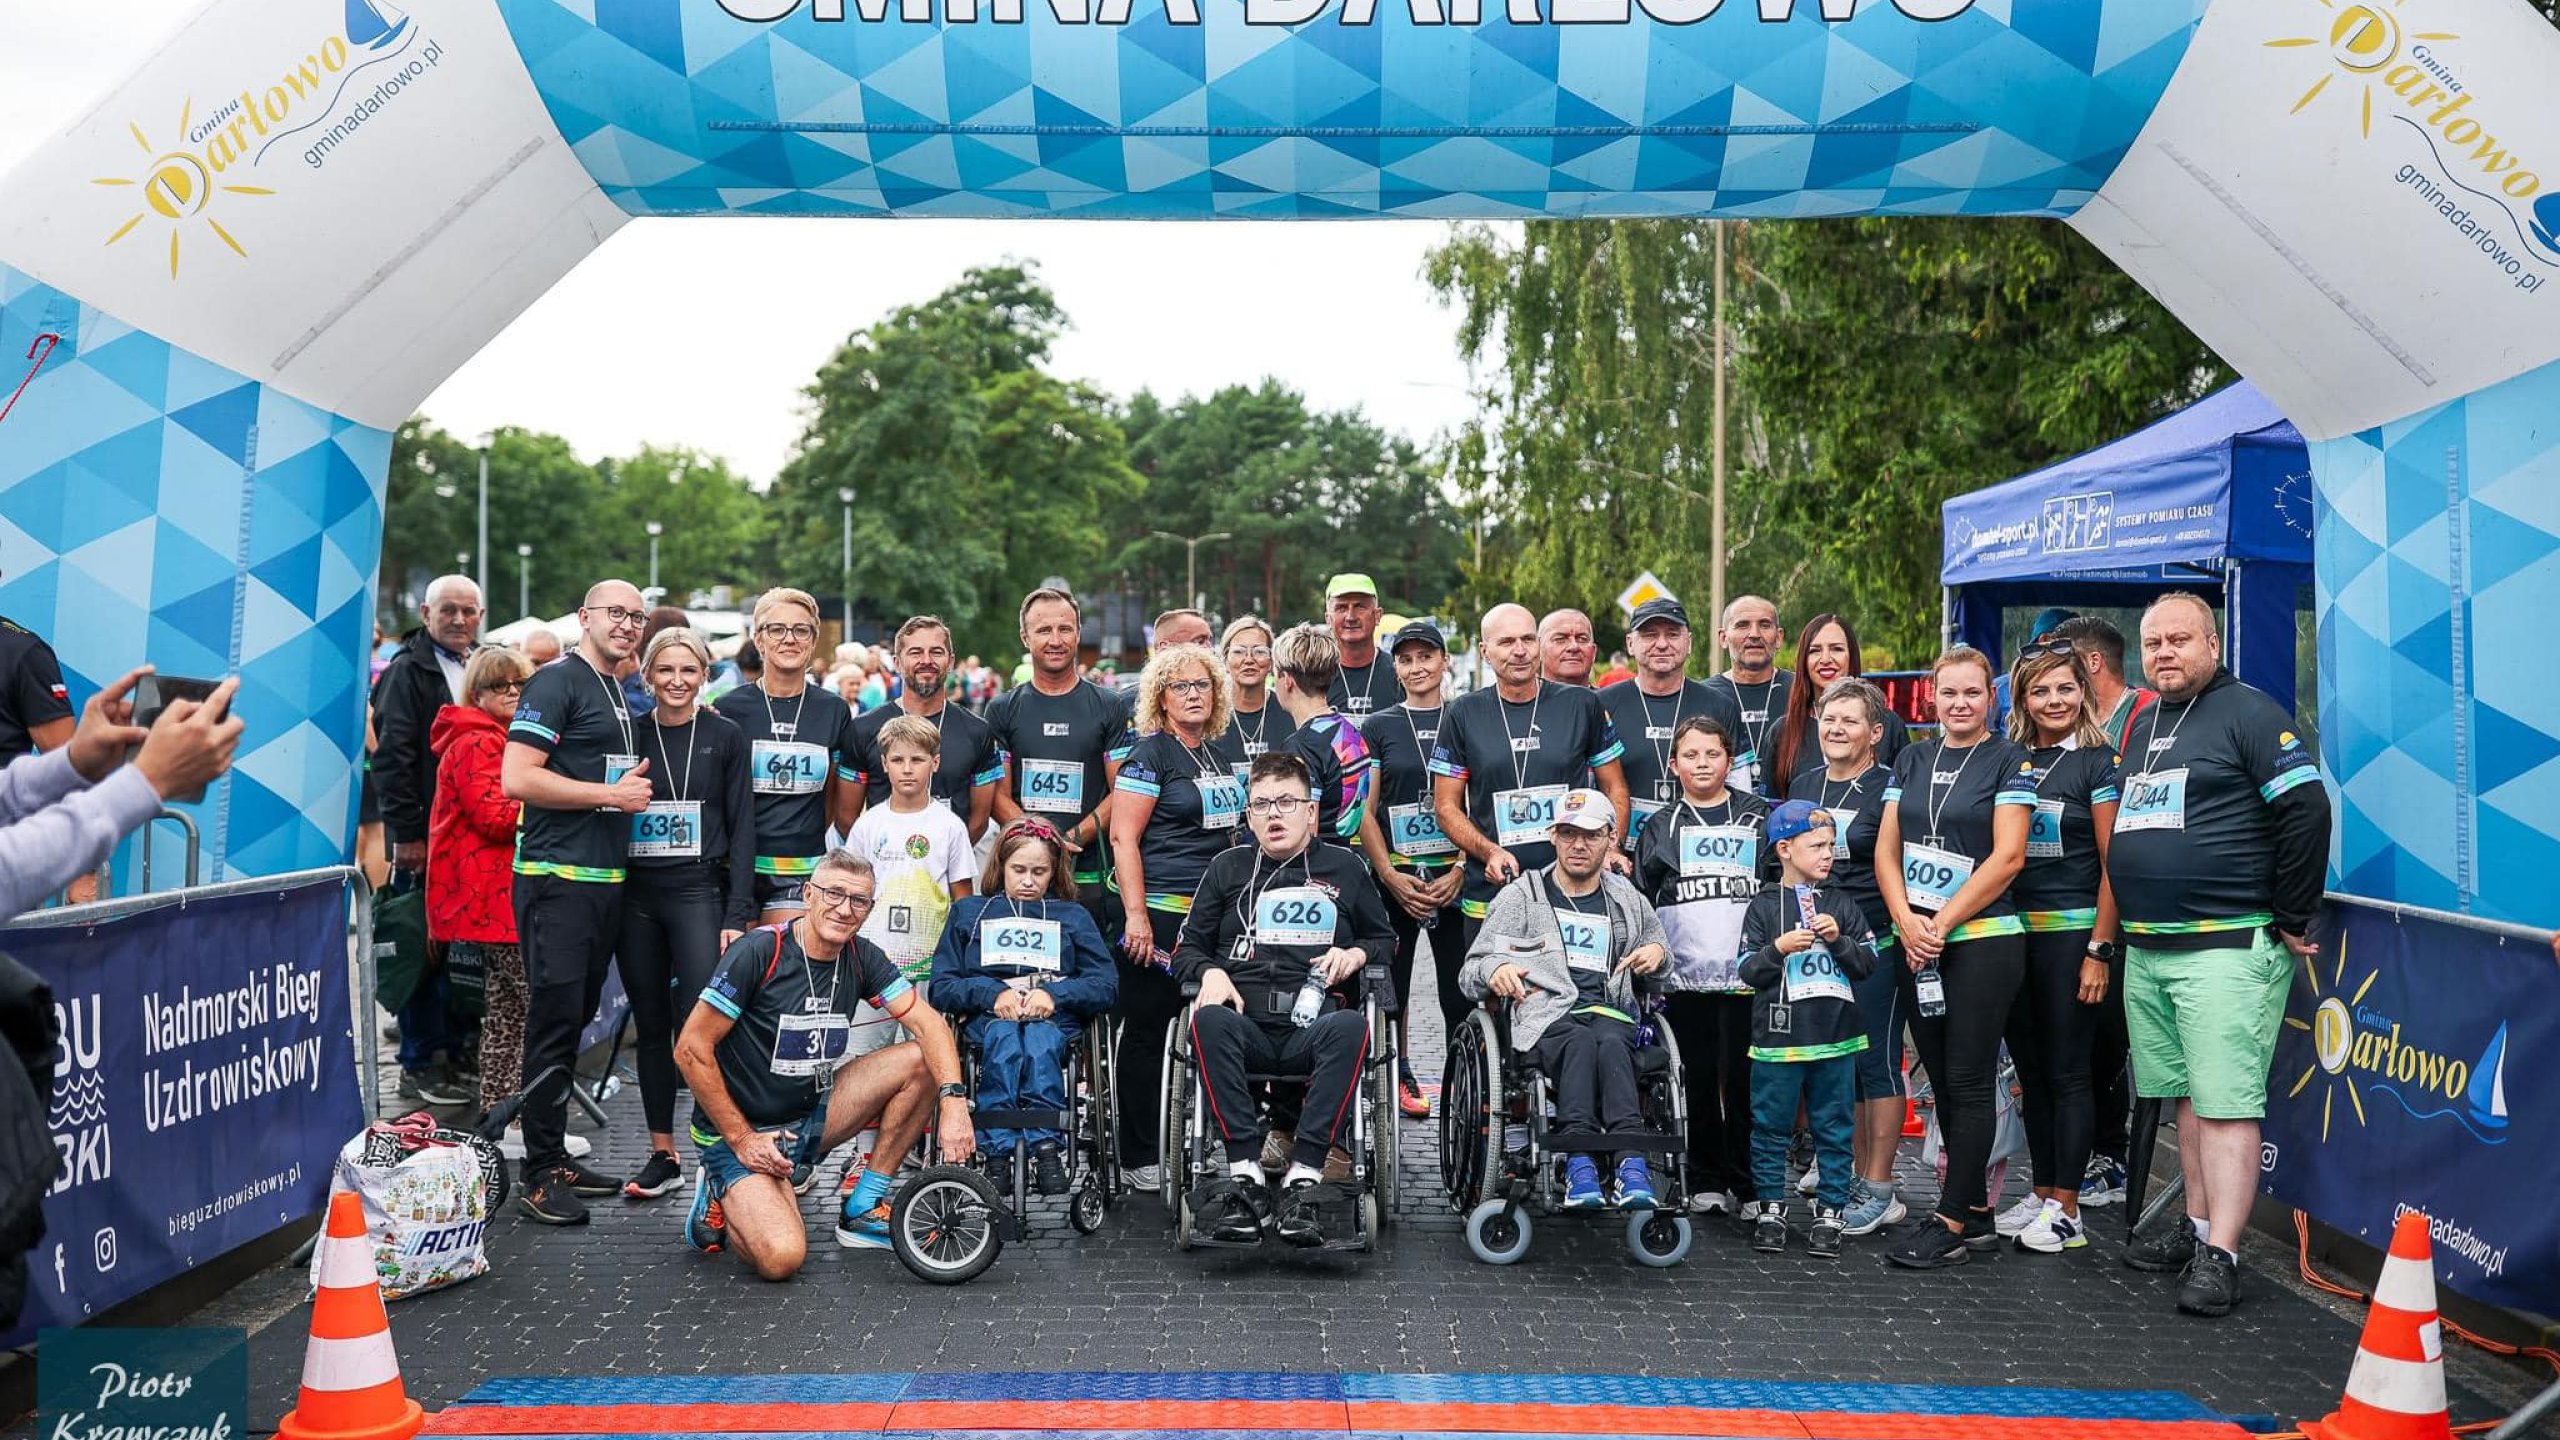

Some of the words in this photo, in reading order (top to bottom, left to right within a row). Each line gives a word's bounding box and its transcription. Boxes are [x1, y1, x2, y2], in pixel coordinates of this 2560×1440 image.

[2412, 43, 2463, 95] Gmina
[303, 38, 444, 169] gminadarlowo.pl
[189, 97, 240, 145] Gmina
[2394, 160, 2546, 295] gminadarlowo.pl
[2115, 512, 2146, 527] SYSTEMY
[2149, 507, 2184, 523] POMIARU
[2188, 504, 2213, 518] CZASU
[767, 754, 813, 776] 641
[1032, 772, 1069, 793] 645
[2143, 784, 2170, 809] 44
[1512, 799, 1555, 824] 01
[1406, 815, 1441, 837] 63
[1696, 838, 1744, 858] 607
[1907, 860, 1953, 888] 609
[1676, 877, 1717, 902] JUST
[1272, 902, 1321, 924] 626
[997, 929, 1045, 951] 632
[1565, 924, 1595, 949] 12
[144, 968, 268, 1055] Nadmorski
[276, 962, 320, 1024] Bieg
[2357, 1005, 2392, 1033] Gmina
[144, 1036, 321, 1132] Uzdrowiskowy
[169, 1162, 300, 1236] bieguzdrowiskowy.pl
